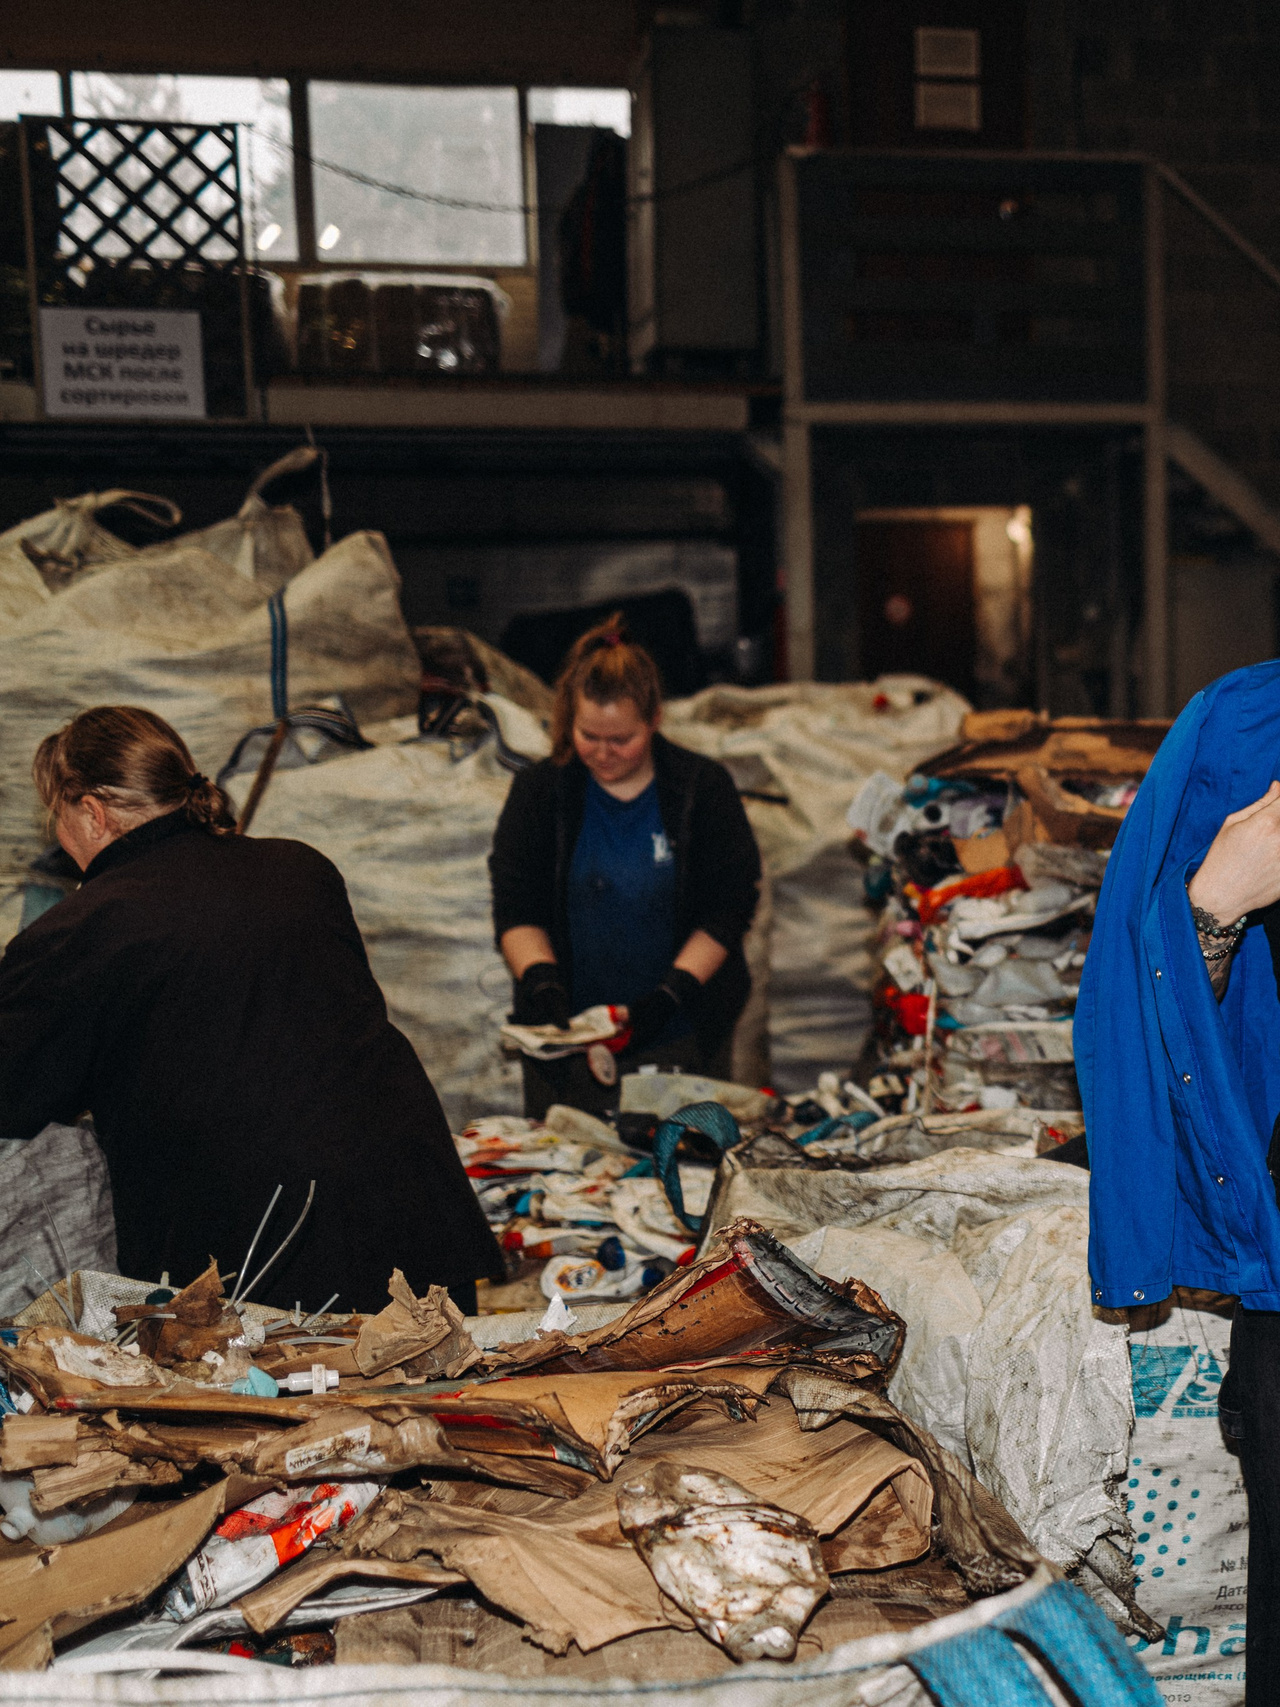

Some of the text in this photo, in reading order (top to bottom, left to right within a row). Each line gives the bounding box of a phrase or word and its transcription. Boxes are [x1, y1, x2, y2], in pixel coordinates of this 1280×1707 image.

[62, 342, 181, 360] на шредер
[63, 362, 182, 381] МСК после
[60, 389, 189, 405] сортировки
